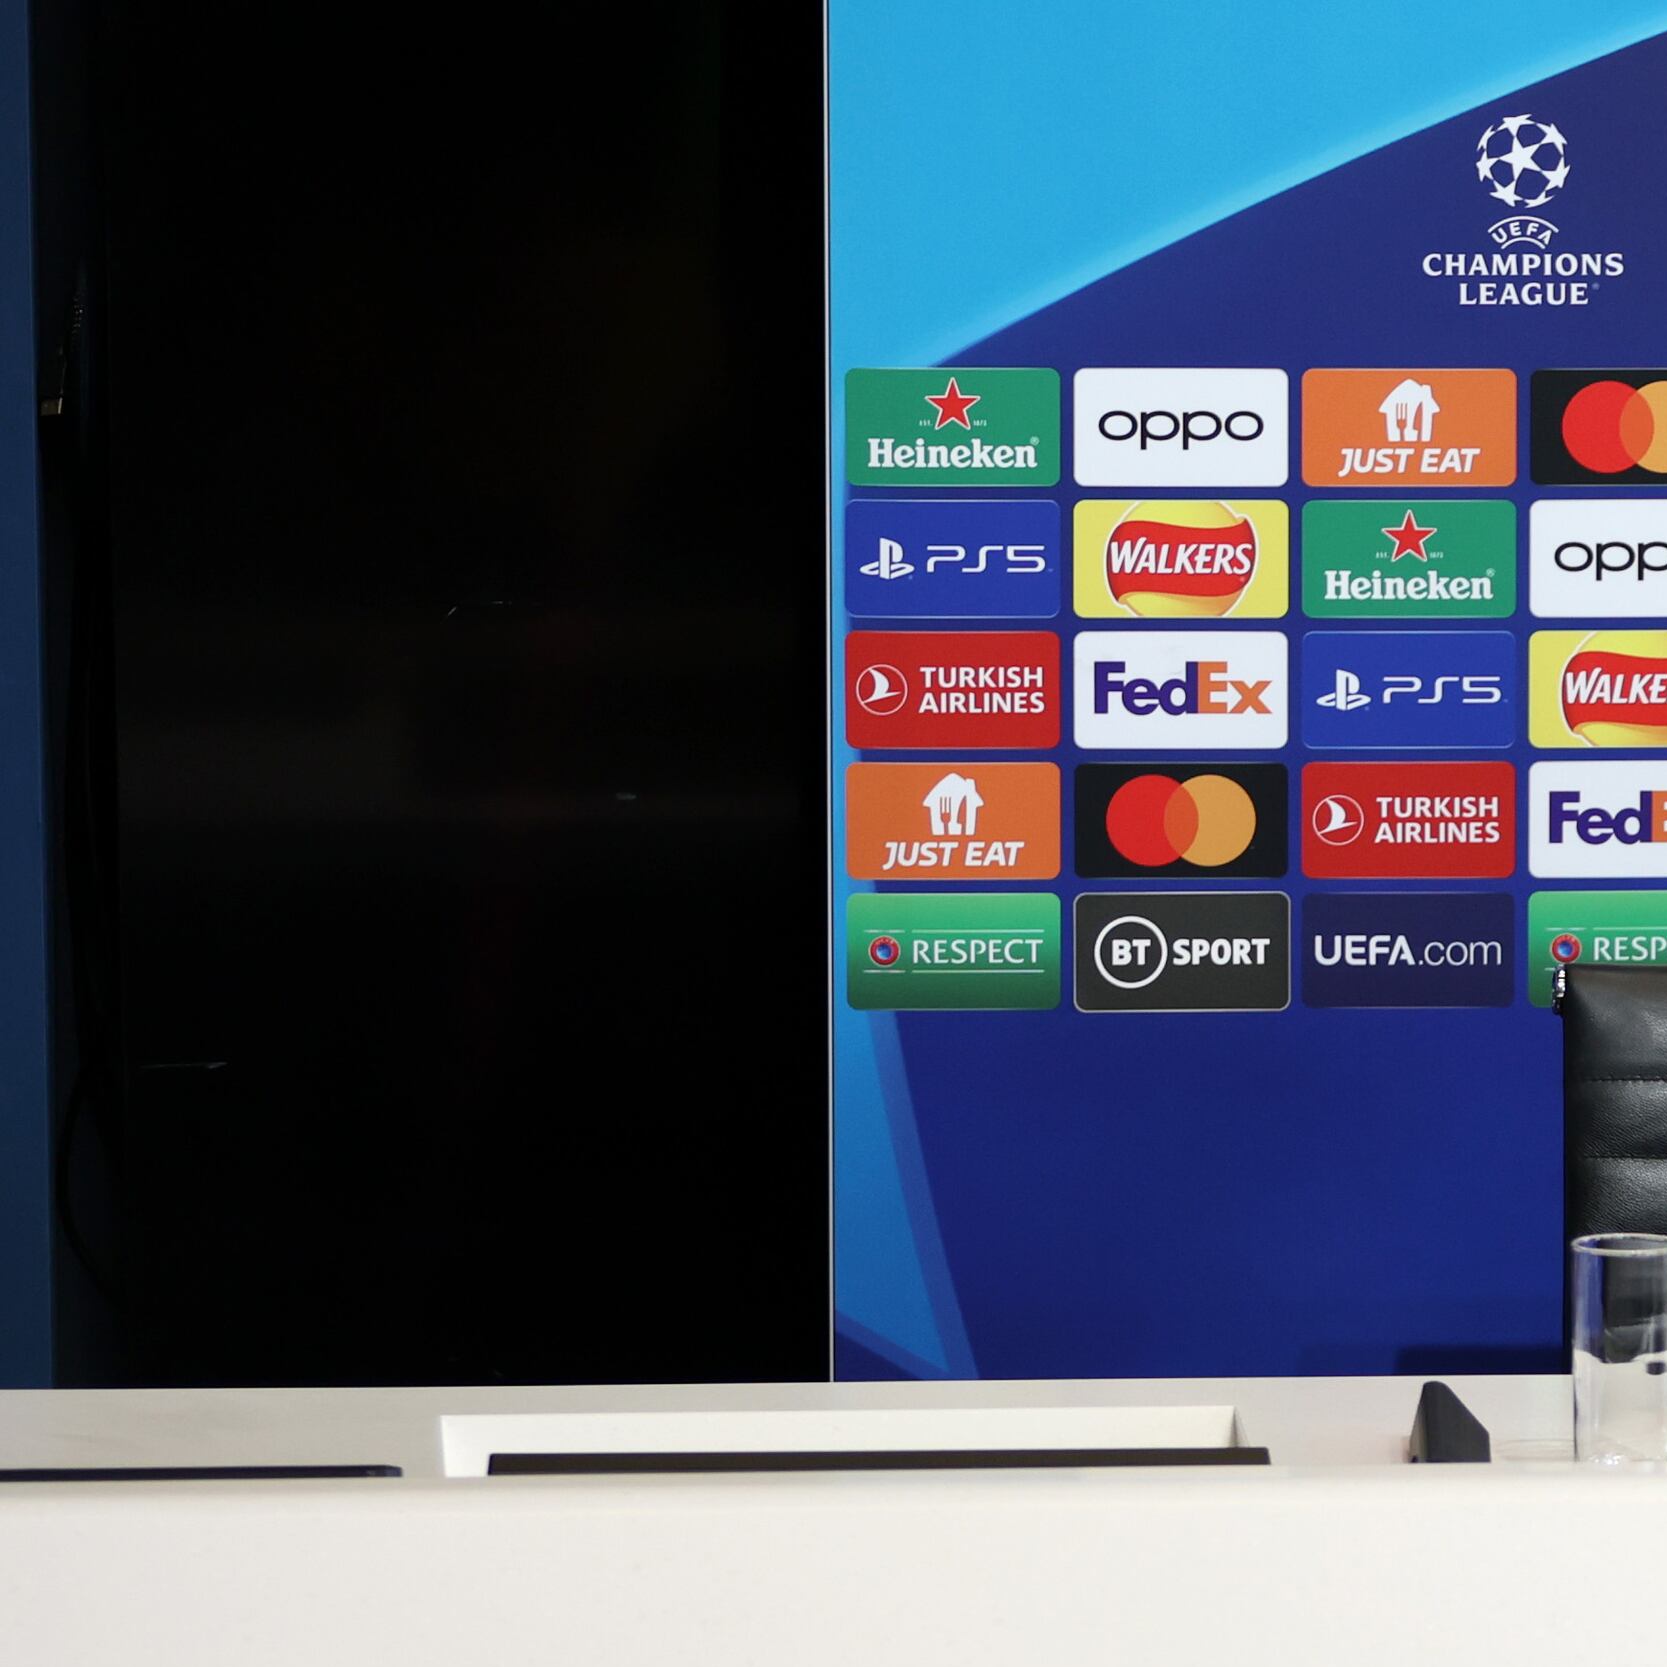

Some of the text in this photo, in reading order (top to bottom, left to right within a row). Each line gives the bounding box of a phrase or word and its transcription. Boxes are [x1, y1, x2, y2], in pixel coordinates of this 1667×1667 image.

[1491, 221, 1553, 245] UEFA
[1423, 254, 1623, 276] CHAMPIONS
[1460, 283, 1588, 305] LEAGUE
[1099, 411, 1263, 450] oppo
[868, 438, 1037, 468] Heineken
[1338, 448, 1480, 477] JUST EAT
[927, 546, 1045, 572] PS5
[1111, 537, 1252, 574] WALKERS
[1325, 570, 1493, 599] Heineken
[920, 667, 1042, 687] TURKISH
[1096, 662, 1269, 714] FedEx
[1383, 677, 1501, 703] PS5
[919, 692, 1044, 713] AIRLINES
[1376, 797, 1497, 817] TURKISH
[1375, 822, 1499, 843] AIRLINES
[883, 842, 1024, 870] JUST EAT
[913, 939, 1043, 963] RESPECT
[1113, 939, 1270, 965] BT SPORT
[1315, 935, 1501, 965] UEFA.com
